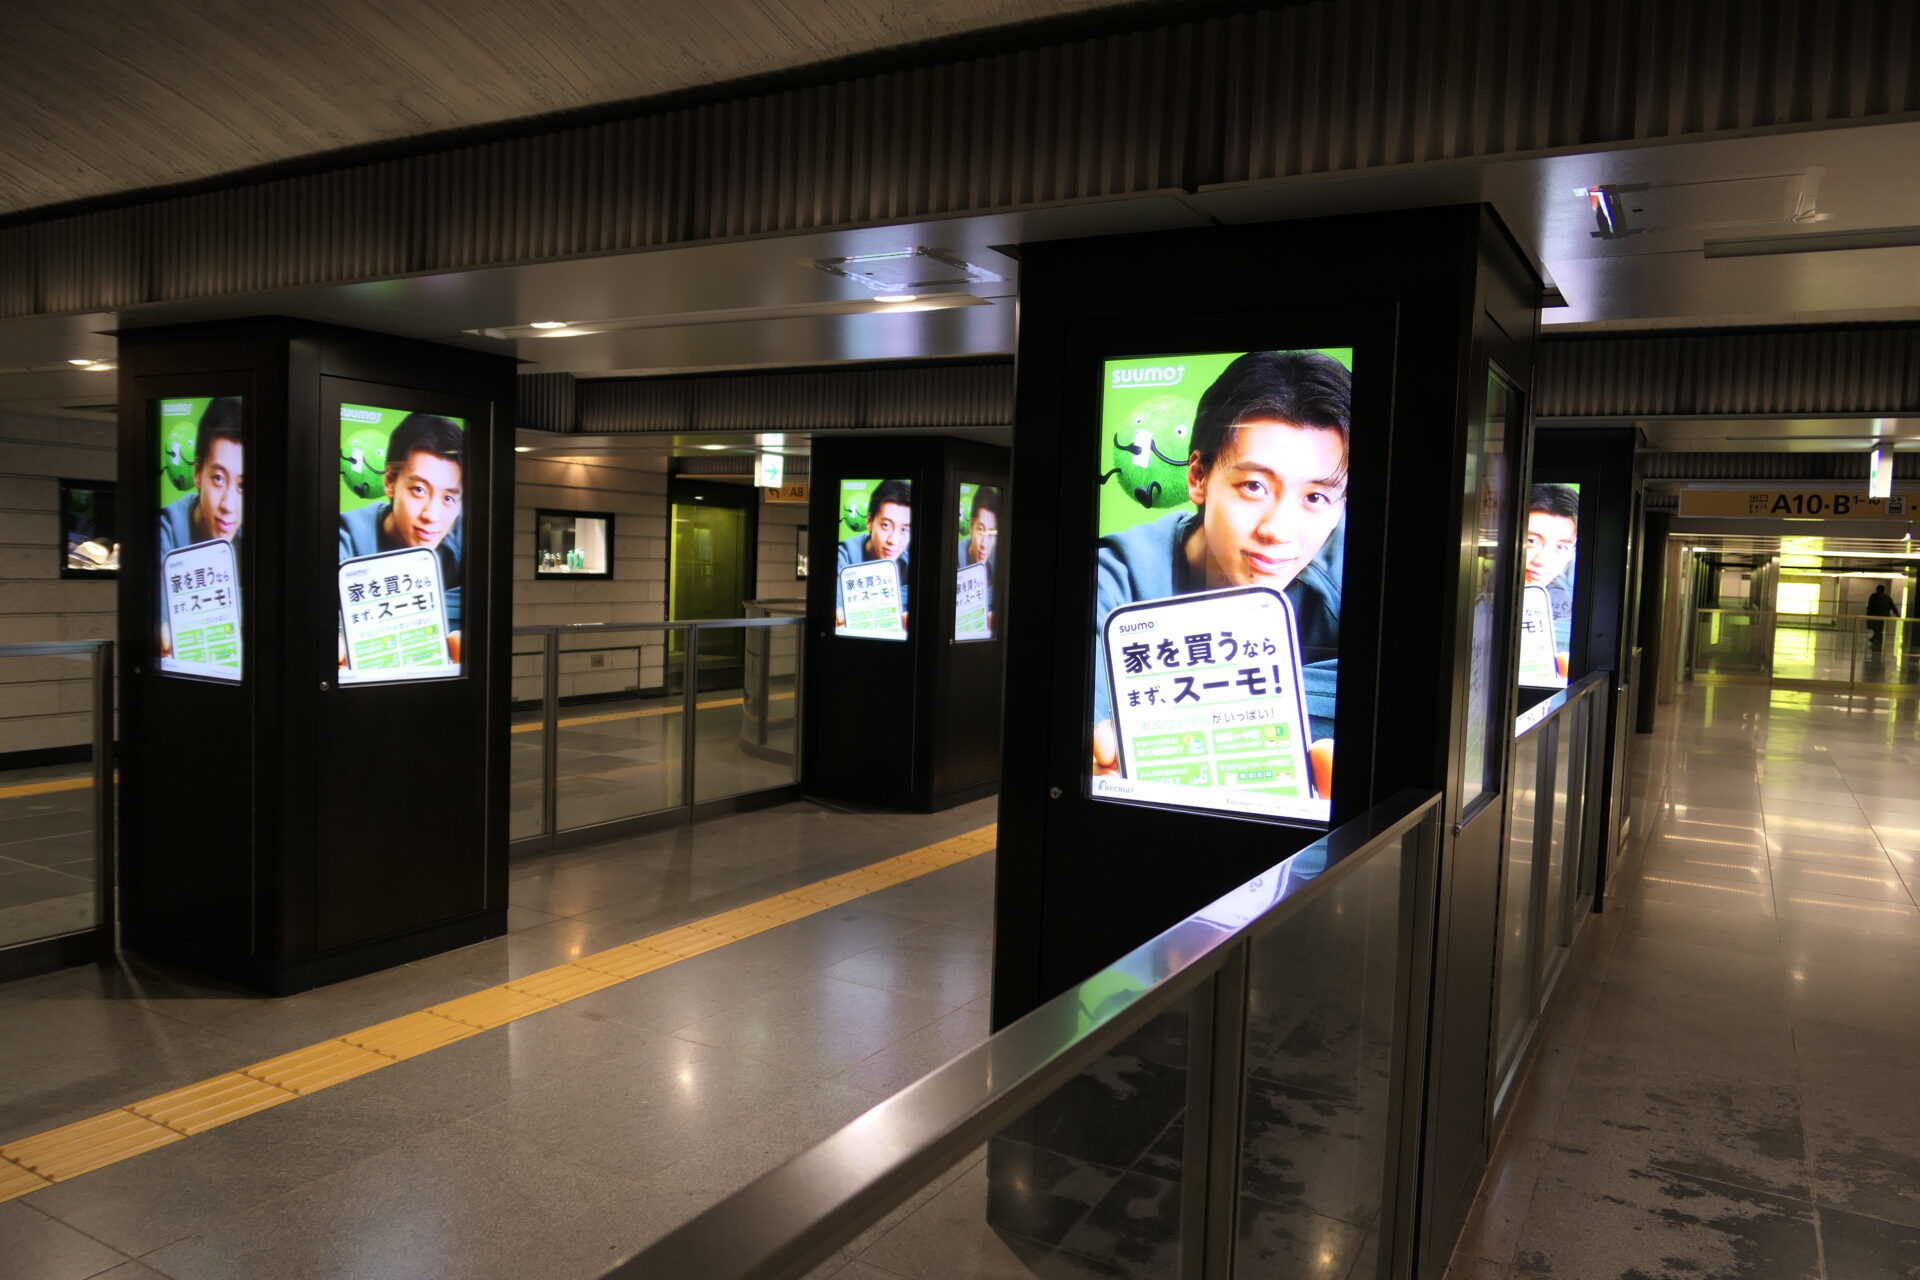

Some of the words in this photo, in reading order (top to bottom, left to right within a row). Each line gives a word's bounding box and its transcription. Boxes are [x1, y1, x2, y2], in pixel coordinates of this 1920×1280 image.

[790, 487, 804, 497] A8
[170, 566, 230, 594] 家を買うなら
[347, 574, 432, 603] 家を買うなら
[1121, 630, 1277, 674] 家を買うなら
[1127, 664, 1284, 707] まず、スーモ!
